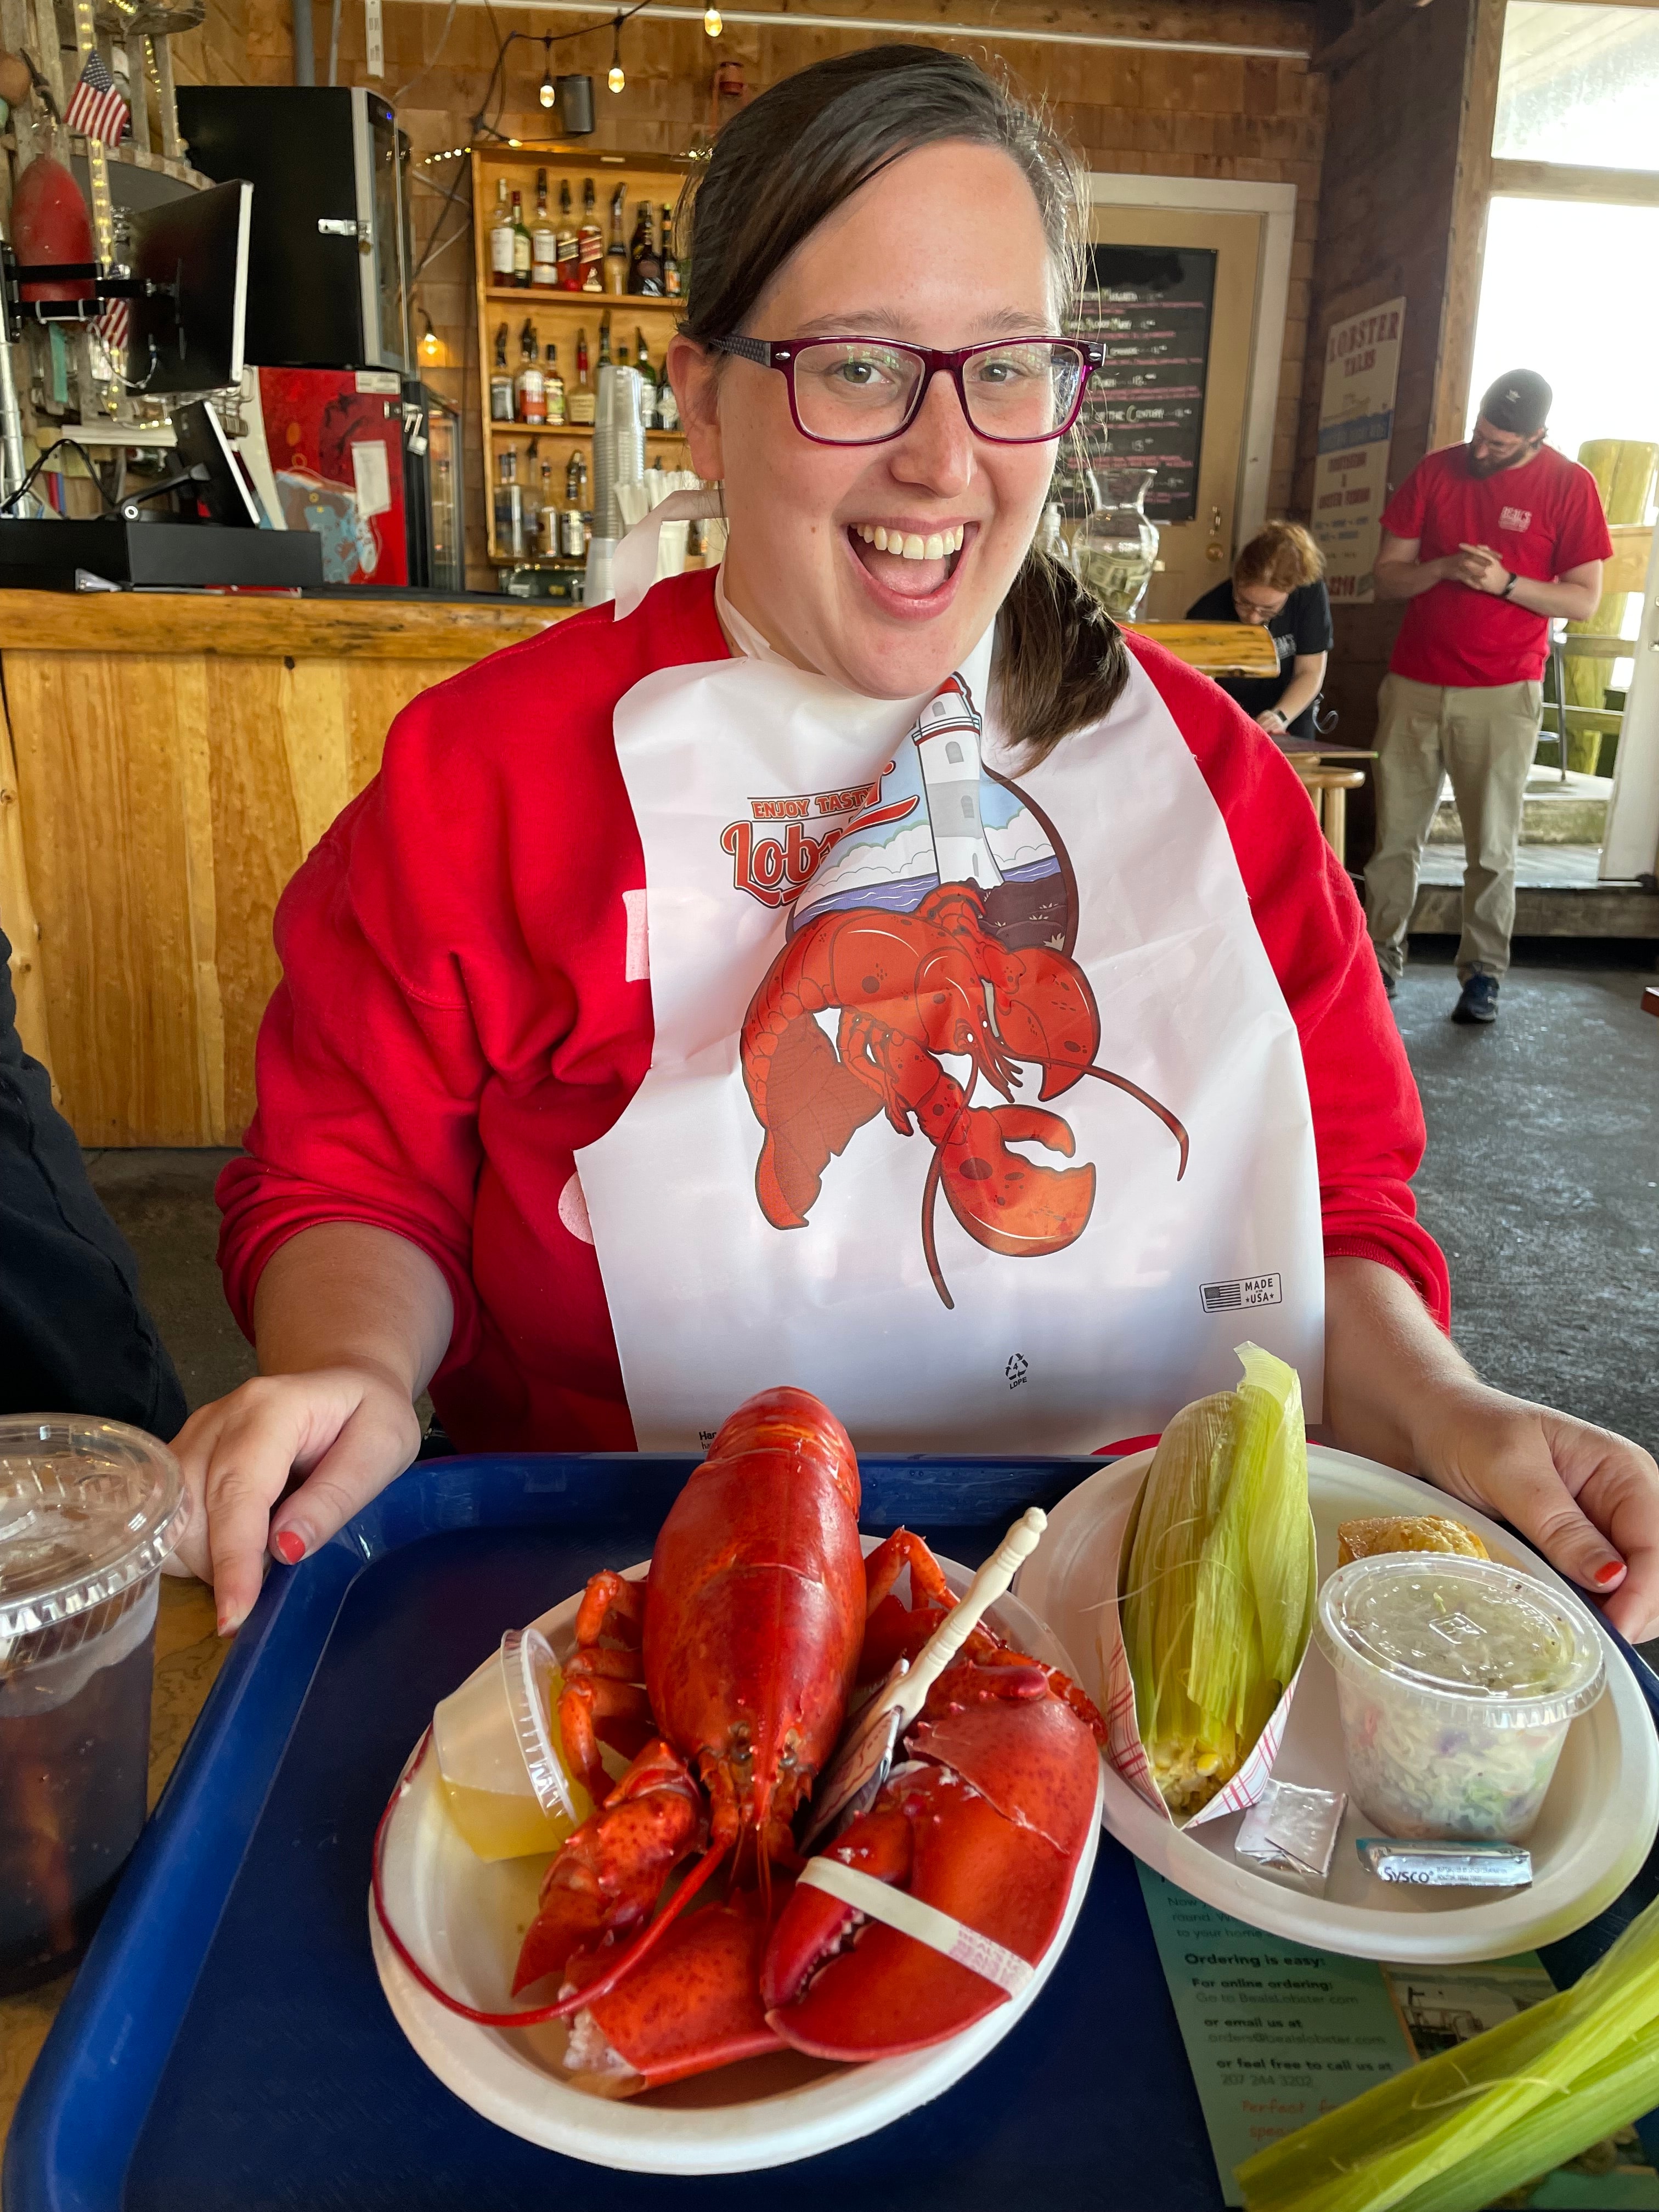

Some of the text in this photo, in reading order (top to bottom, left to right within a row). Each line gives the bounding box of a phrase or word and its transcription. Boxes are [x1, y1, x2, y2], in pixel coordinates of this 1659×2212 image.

[751, 798, 809, 819] ENJOY
[1245, 1278, 1273, 1291] MADE
[1251, 1292, 1269, 1304] USA
[1013, 1362, 1019, 1370] 4
[1009, 1376, 1028, 1390] LDPE
[1167, 1897, 1197, 1907] Now
[1177, 1929, 1263, 1940] to your home
[1184, 1953, 1325, 1968] Ordering is easy:
[1192, 1978, 1334, 1991] For online ordering:
[1196, 1991, 1217, 2002] Go
[1221, 1993, 1235, 2003] to
[1203, 2017, 1304, 2028] or email us at
[1216, 2057, 1393, 2072] or feel free to call us at
[1221, 2073, 1245, 2086] 207
[1249, 2074, 1276, 2086] 244
[1242, 2098, 1305, 2114] Perfect
